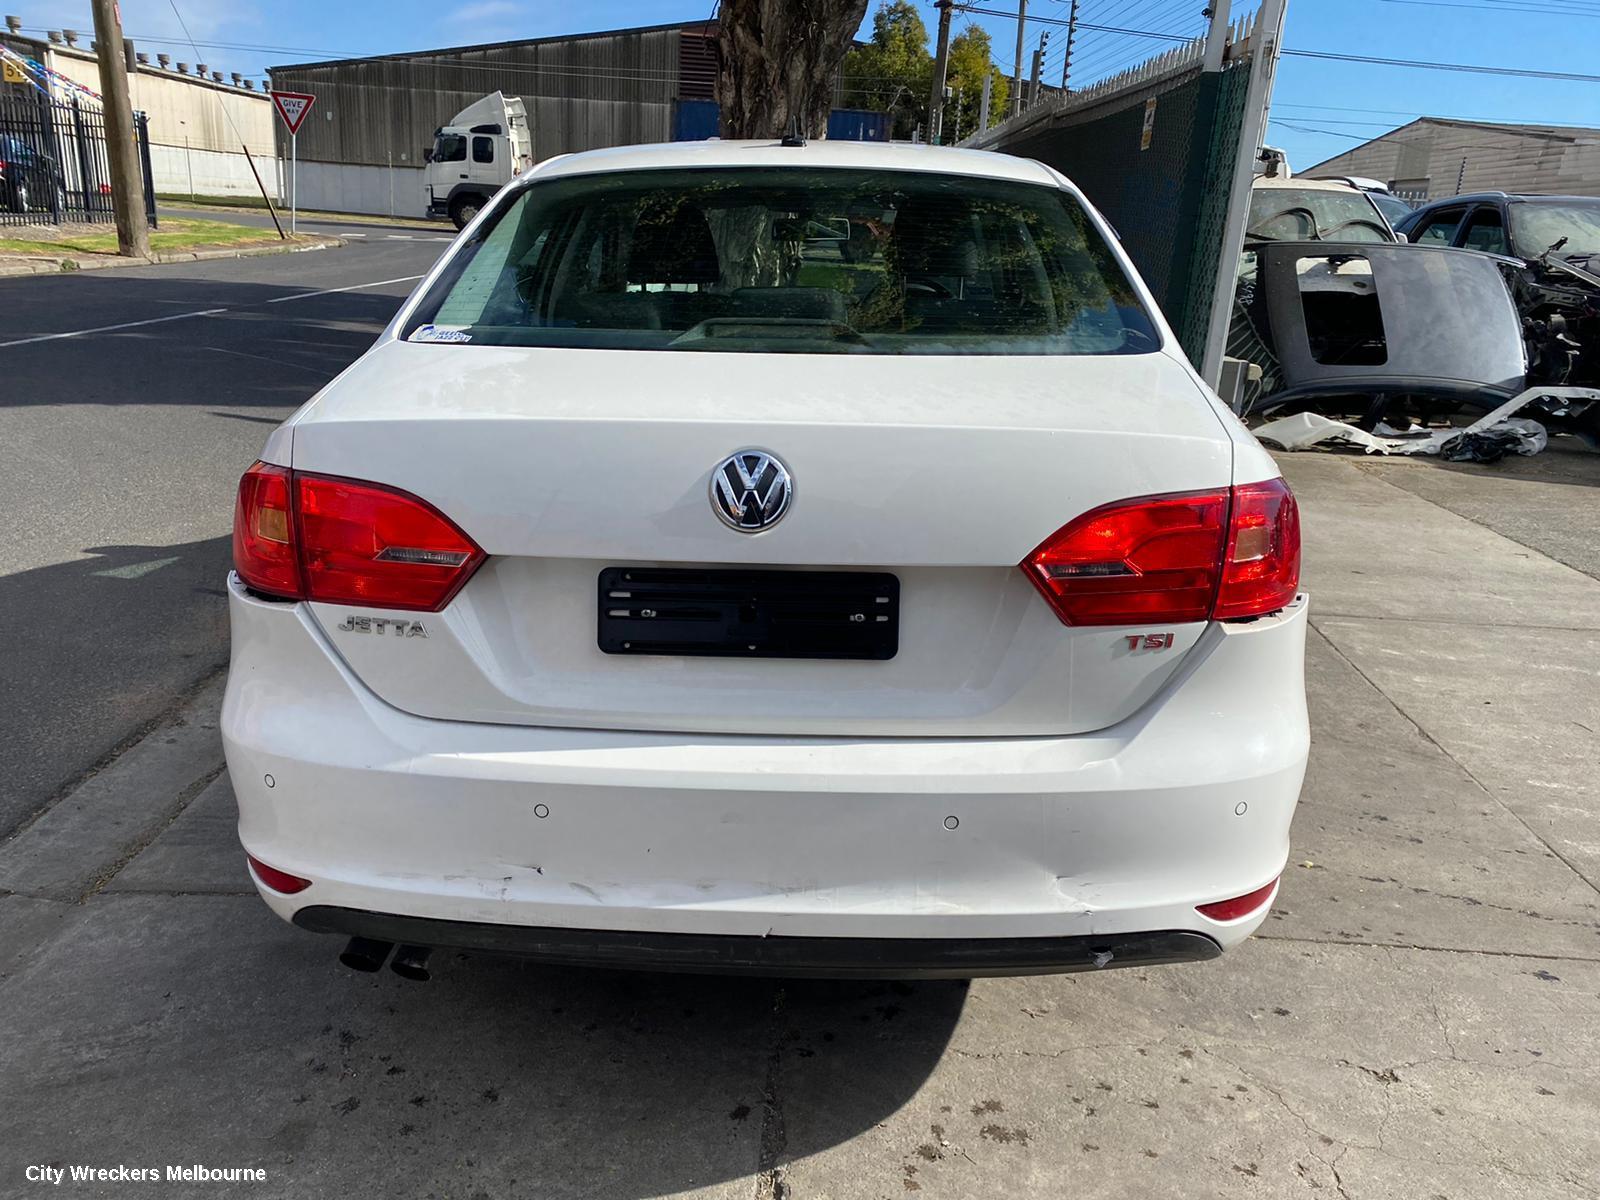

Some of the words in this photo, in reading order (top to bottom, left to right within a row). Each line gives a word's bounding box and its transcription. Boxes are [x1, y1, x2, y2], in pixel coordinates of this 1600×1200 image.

[283, 99, 302, 108] GIVE
[337, 615, 430, 638] JETTA
[1124, 632, 1175, 650] TSI
